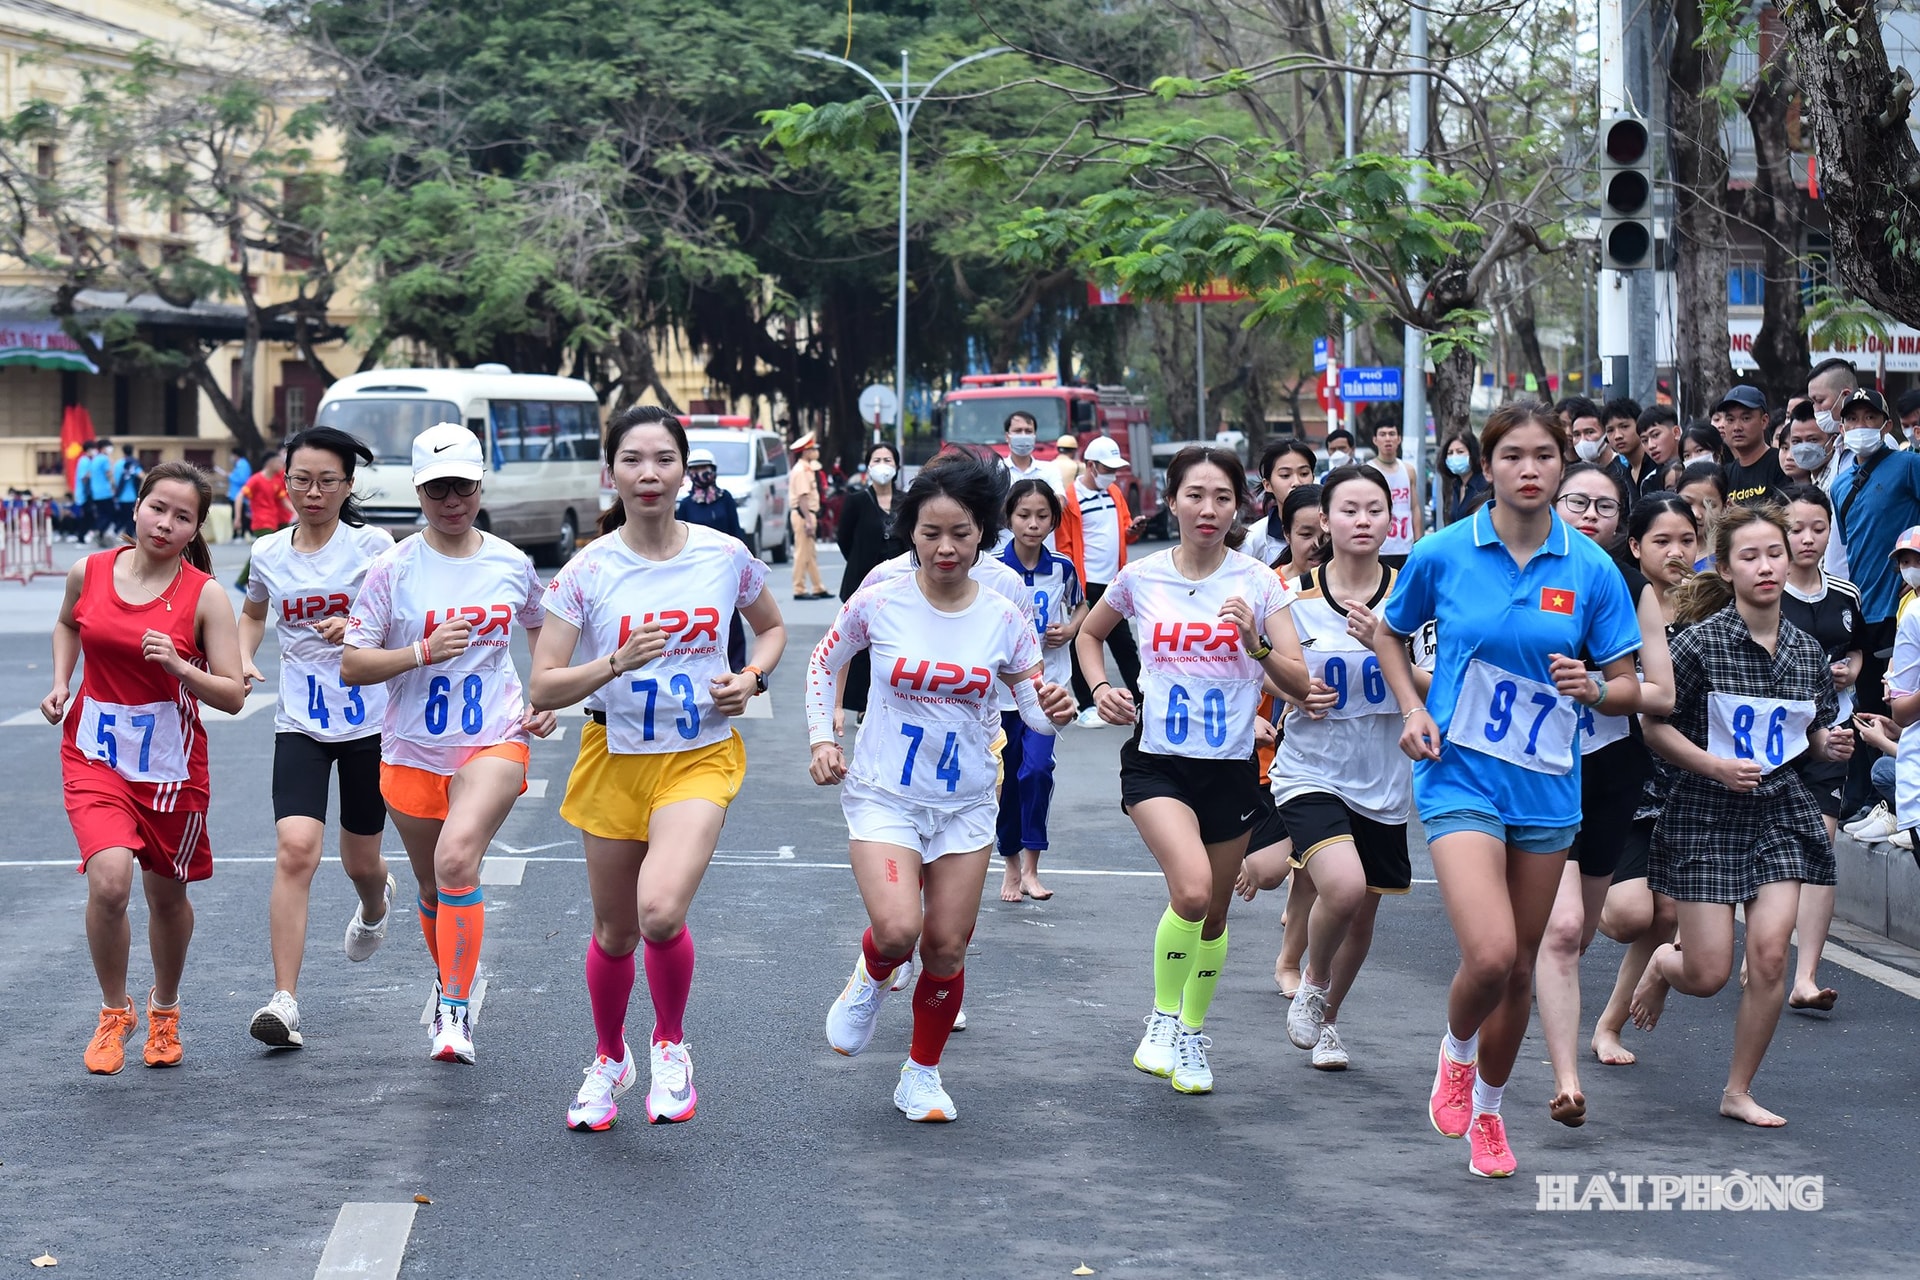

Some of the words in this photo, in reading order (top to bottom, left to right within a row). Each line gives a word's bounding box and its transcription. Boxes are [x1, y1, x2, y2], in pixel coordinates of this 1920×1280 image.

[1391, 488, 1410, 500] PR
[282, 592, 350, 622] HPR
[423, 604, 513, 639] HPR
[617, 606, 720, 652] HPR
[470, 640, 509, 648] RUNNERS
[674, 645, 717, 656] RUNNERS
[1152, 622, 1240, 652] HPR
[306, 673, 365, 729] 43
[890, 657, 992, 699] HPR
[893, 690, 908, 701] HAI
[909, 694, 944, 705] PHONG
[945, 697, 982, 712] RUNNERS
[1324, 655, 1387, 711] 96
[424, 674, 483, 736] 68
[631, 673, 701, 742] 73
[1165, 683, 1227, 748] 60
[1484, 680, 1558, 756] 97
[96, 712, 156, 773] 57
[900, 722, 961, 793] 74
[1733, 704, 1787, 766] 86
